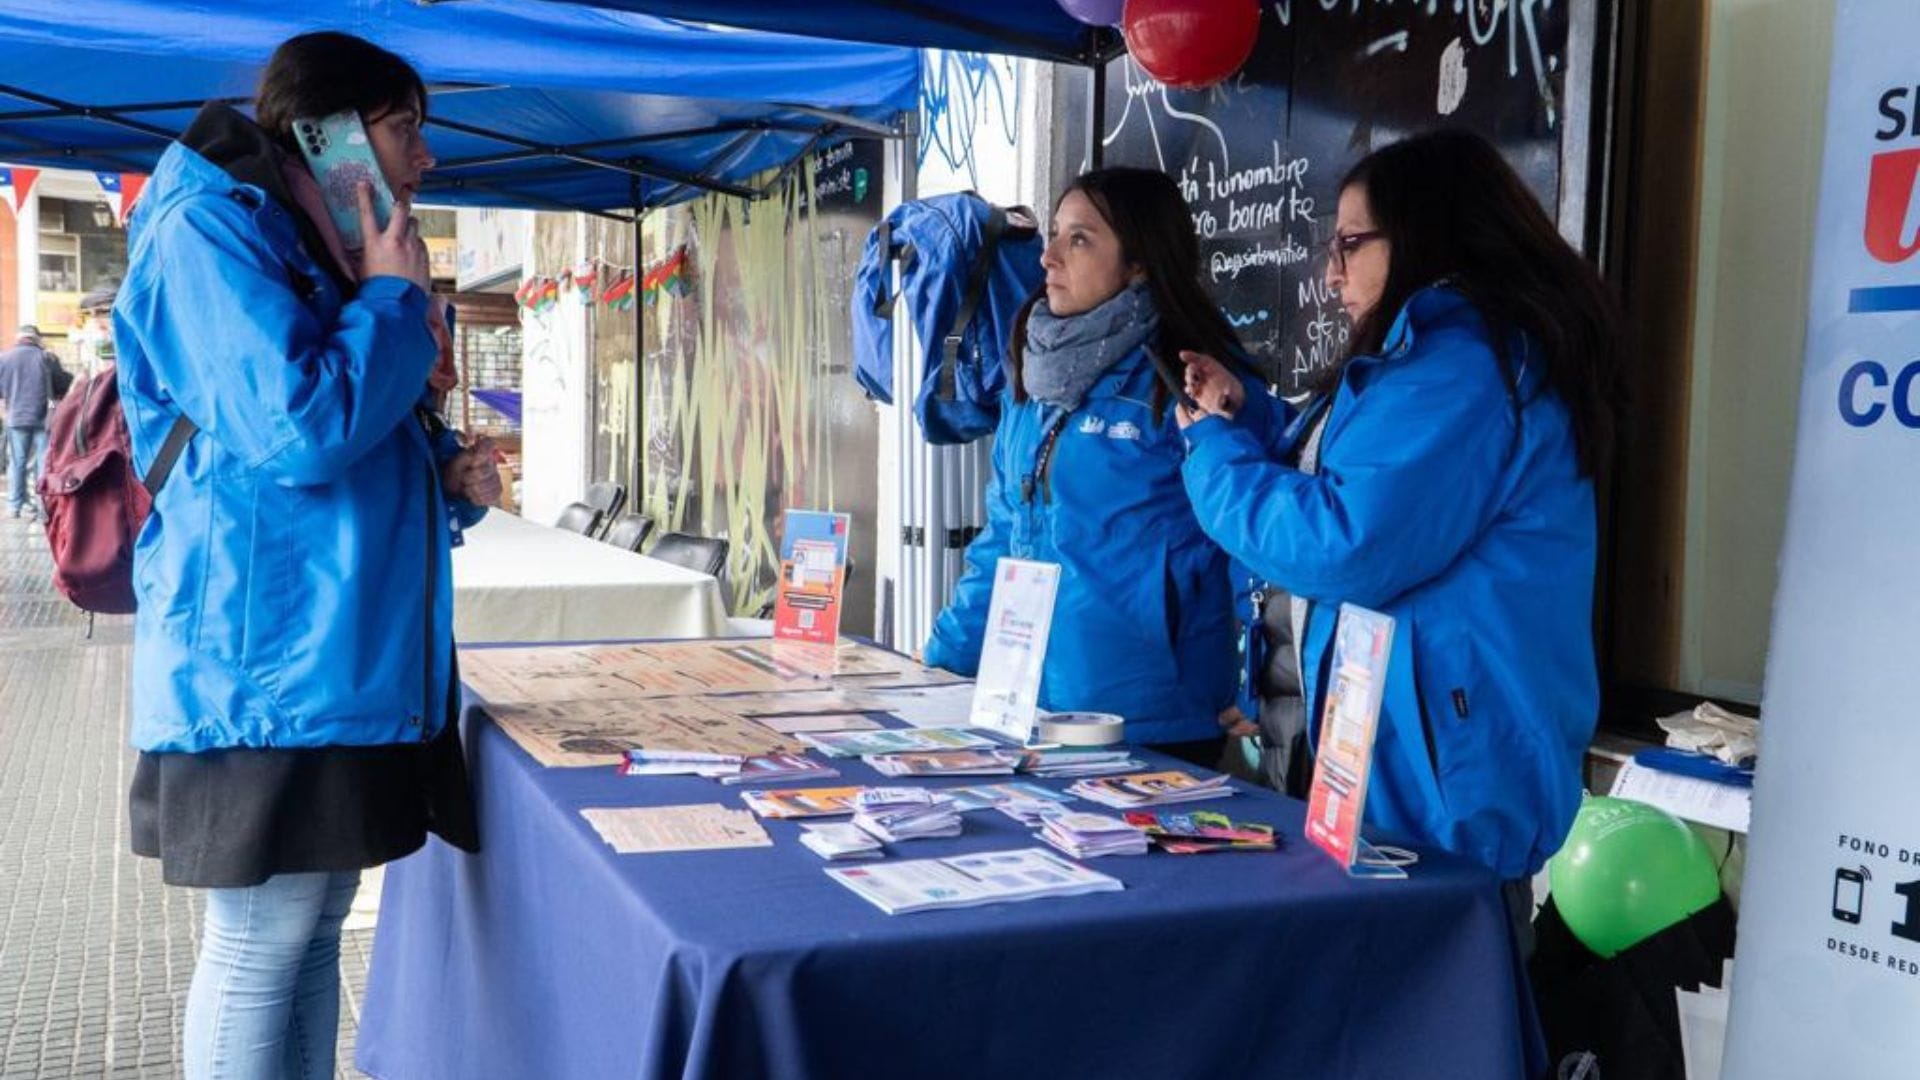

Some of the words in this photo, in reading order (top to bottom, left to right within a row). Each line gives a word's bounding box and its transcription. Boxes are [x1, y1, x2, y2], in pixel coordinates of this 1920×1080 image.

[1838, 834, 1889, 858] FONO
[1827, 937, 1880, 964] DESDE
[1887, 955, 1919, 976] RED
